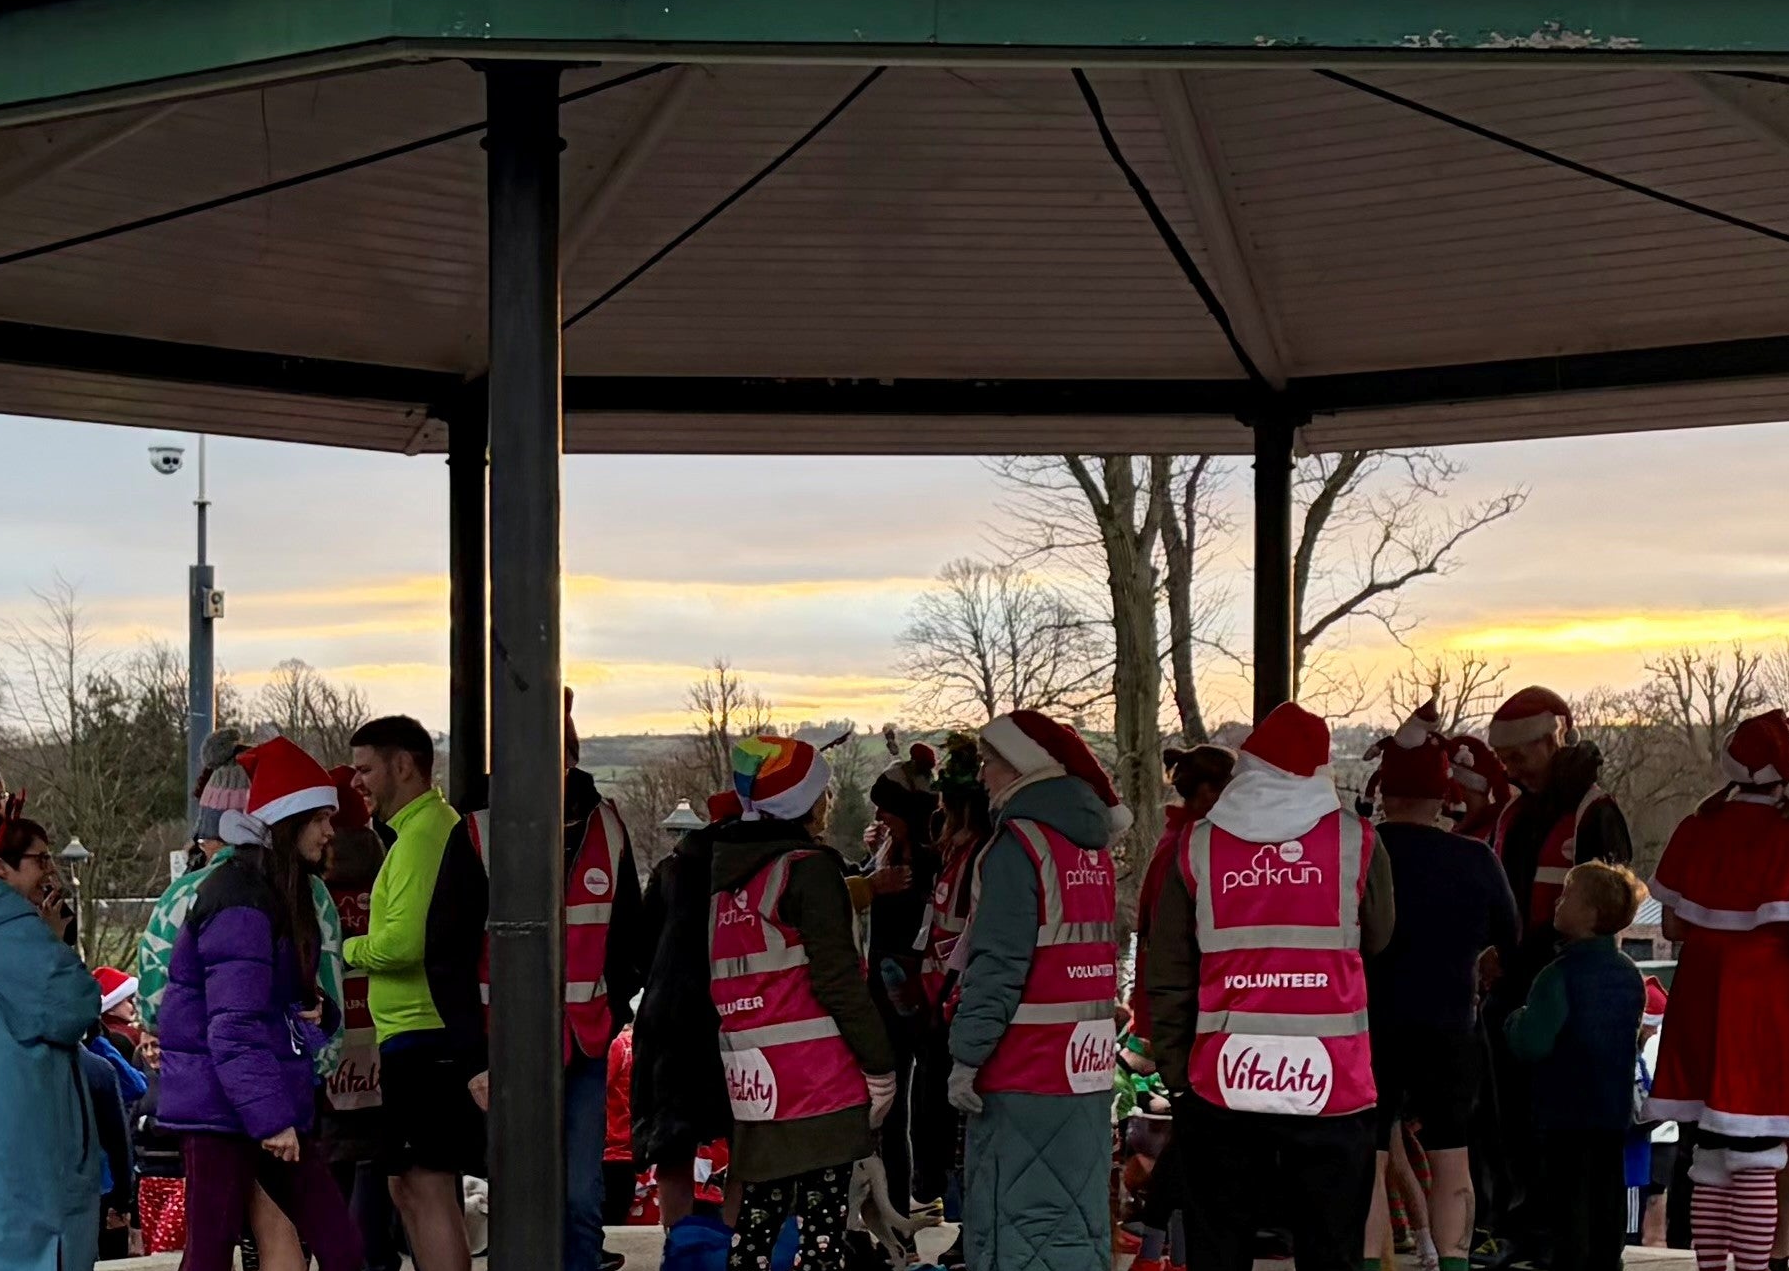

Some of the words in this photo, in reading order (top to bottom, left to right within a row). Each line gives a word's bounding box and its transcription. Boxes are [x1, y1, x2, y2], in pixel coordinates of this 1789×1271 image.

[1223, 857, 1322, 894] parkrun
[1224, 973, 1329, 990] VOLUNTEER
[328, 1058, 380, 1094] Vital
[1223, 1046, 1328, 1106] Vitality
